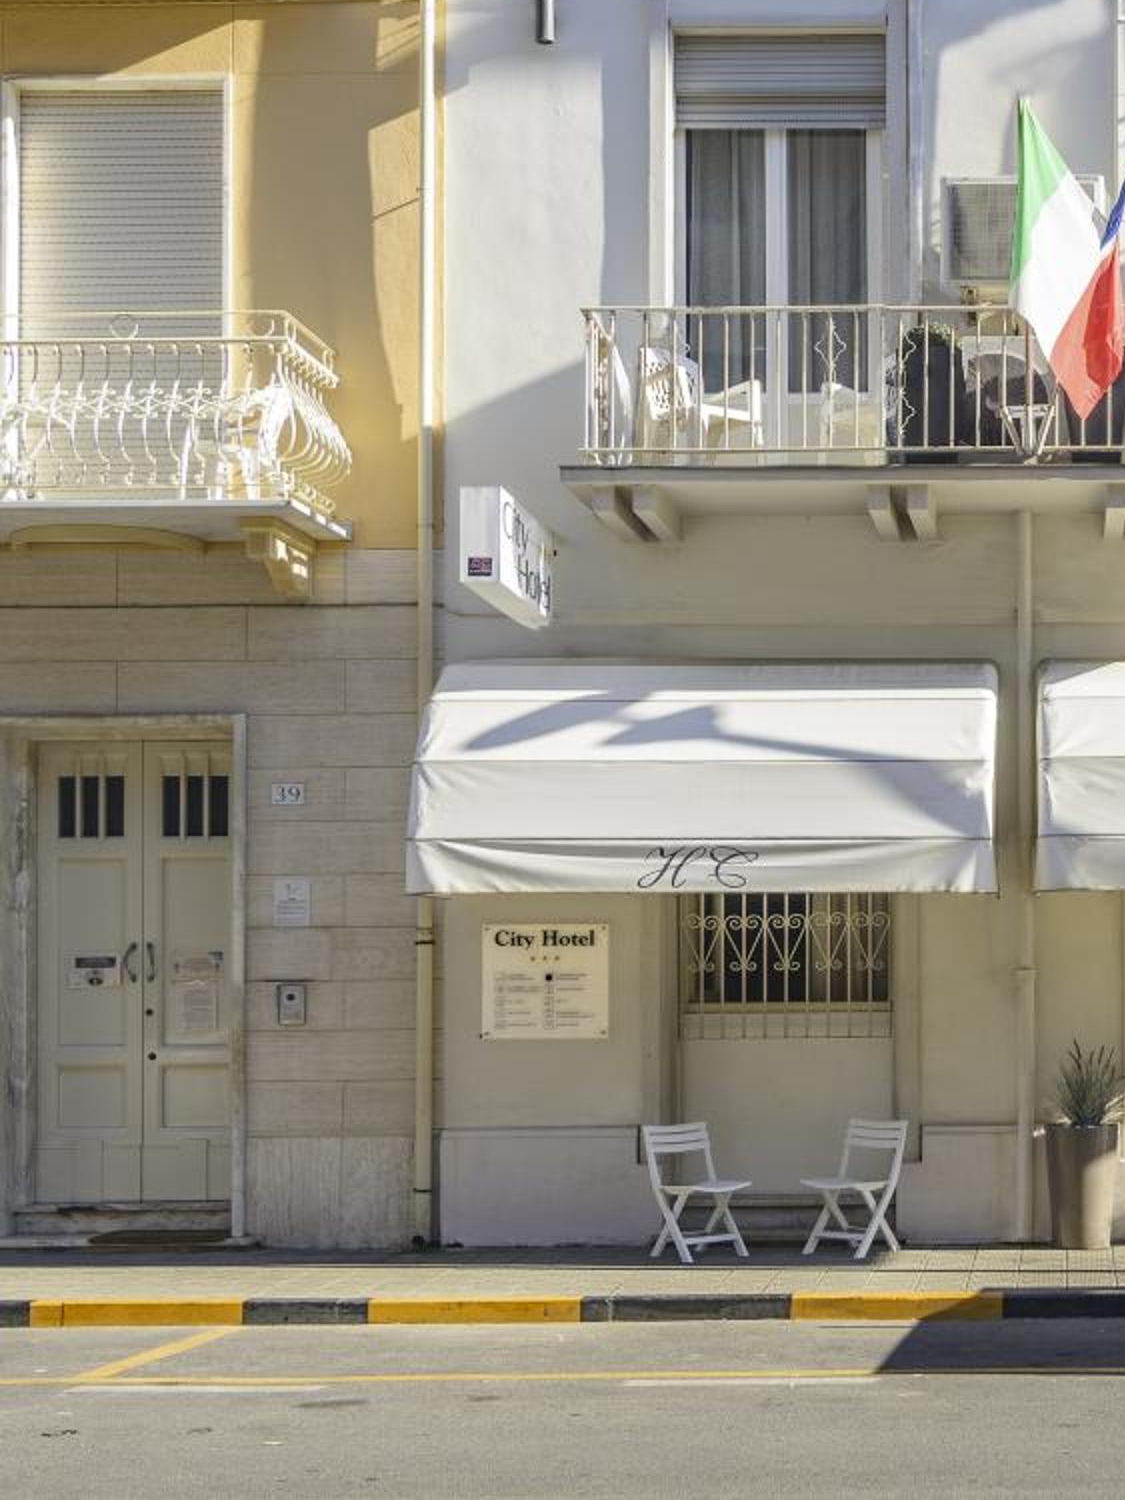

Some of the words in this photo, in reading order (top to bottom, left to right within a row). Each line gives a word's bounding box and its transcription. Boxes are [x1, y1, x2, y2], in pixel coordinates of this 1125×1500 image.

[503, 501, 530, 555] City
[494, 929, 535, 950] City
[541, 929, 595, 947] Hotel
